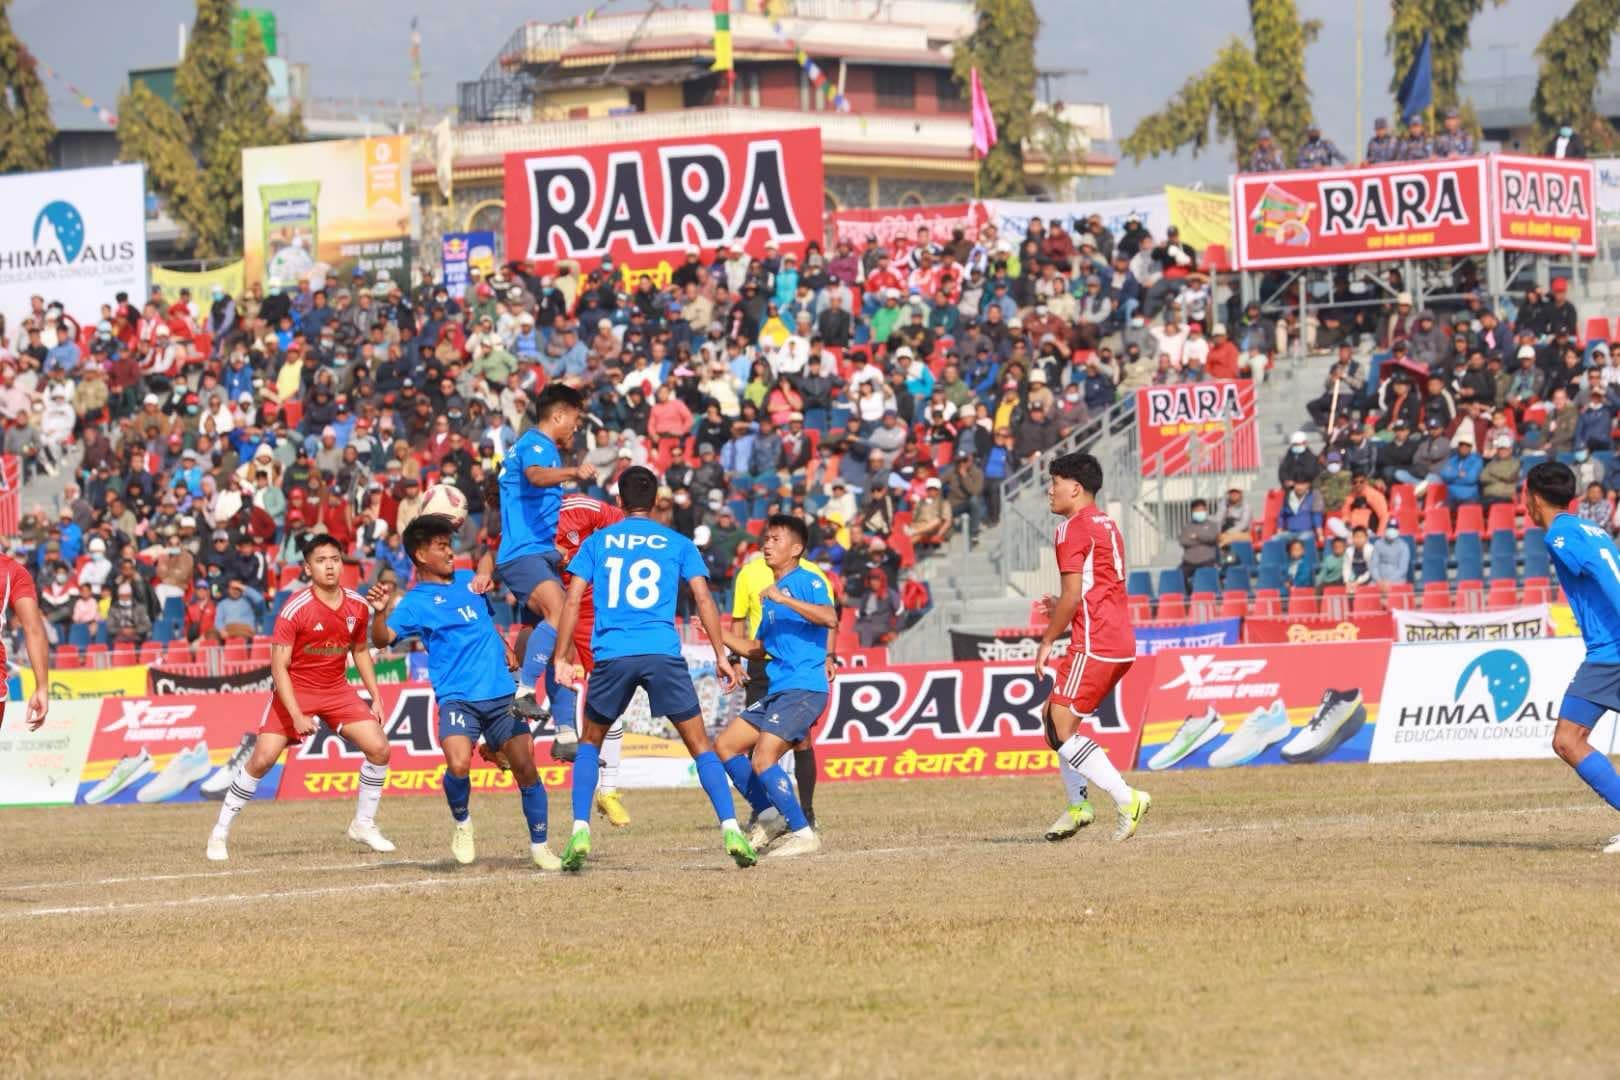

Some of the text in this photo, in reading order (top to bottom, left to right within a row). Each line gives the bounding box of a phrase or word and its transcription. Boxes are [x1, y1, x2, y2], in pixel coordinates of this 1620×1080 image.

[525, 139, 804, 261] RARA
[1317, 171, 1470, 236] RARA
[1500, 168, 1589, 220] RARA
[81, 242, 135, 263] AUS
[1148, 384, 1245, 427] RARA
[605, 533, 669, 550] NPC
[604, 556, 662, 609] 18
[457, 604, 478, 622] 14
[448, 711, 466, 728] 14
[1398, 701, 1560, 727] HIMA AU
[1395, 725, 1556, 743] EDUCATION CONSULT
[824, 756, 887, 779] रारा
[894, 747, 987, 775] तैयारी
